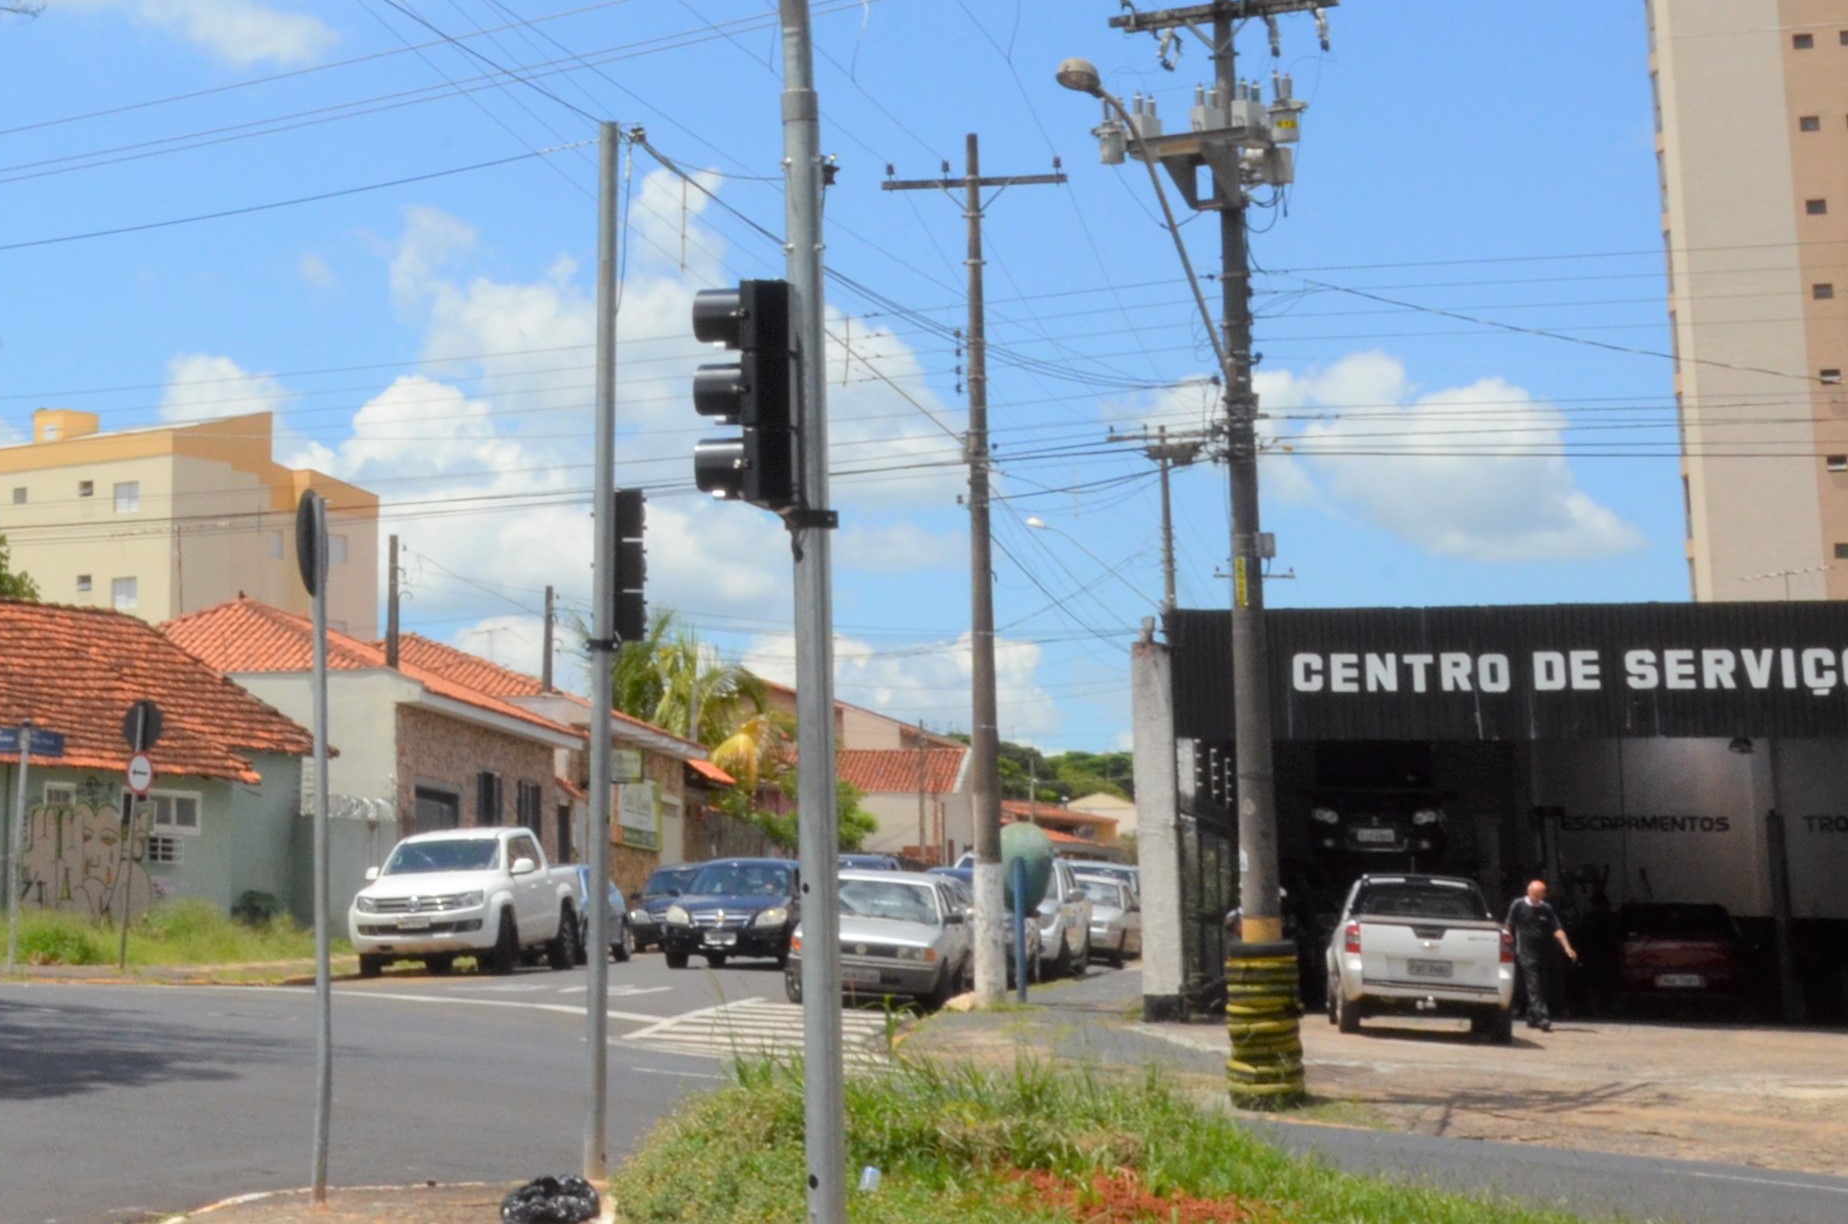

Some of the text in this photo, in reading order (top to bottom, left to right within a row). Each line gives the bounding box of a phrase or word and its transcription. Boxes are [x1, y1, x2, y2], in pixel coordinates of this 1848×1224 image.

[1292, 648, 1848, 696] CENTRO DE SERVIÇ
[1561, 816, 1730, 833] ESCAPAMENTOS
